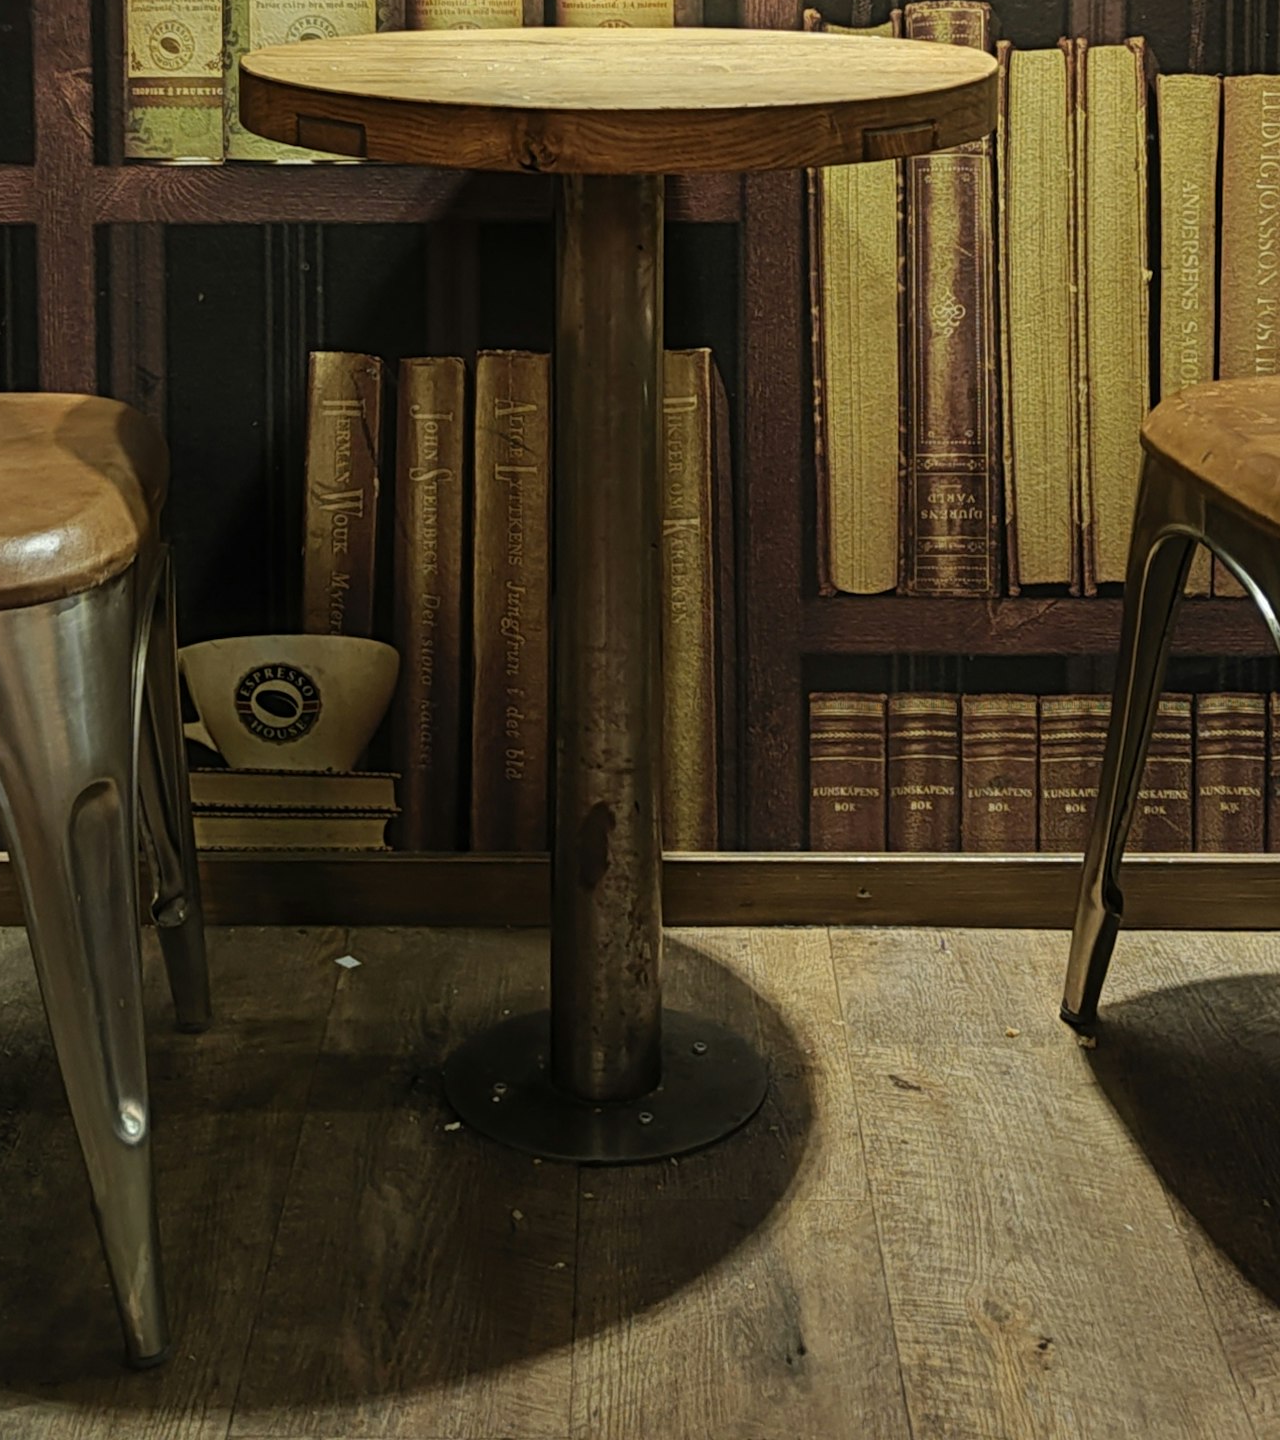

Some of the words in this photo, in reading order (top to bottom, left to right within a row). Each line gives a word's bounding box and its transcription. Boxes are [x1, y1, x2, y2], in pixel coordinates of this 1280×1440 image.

[176, 87, 223, 95] FRUKTIG
[1180, 179, 1200, 310] ANDERSENS
[409, 404, 453, 460] JOHN
[494, 398, 537, 458] ALICE
[663, 393, 698, 473] DIKTER
[668, 482, 685, 511] OM
[927, 494, 975, 505] VÄRLD
[920, 506, 983, 519] DJURENS
[409, 467, 456, 576] STEINBECK
[501, 581, 526, 676] Jungfrun
[240, 667, 313, 697] ESPRESSO
[506, 705, 526, 738] det
[250, 719, 307, 739] HOUSE
[812, 787, 880, 798] KUNSKAPENS
[891, 785, 956, 797] KUNSKAPENS
[967, 788, 1033, 799] KUNSKAPENS
[1199, 785, 1262, 797] KUNSKAPENS
[834, 802, 857, 813] BOK
[910, 800, 933, 811] BOK
[988, 802, 1011, 813] BOK
[1065, 803, 1087, 814] BOK
[1143, 805, 1167, 816] BOK
[1220, 801, 1240, 813] BOK
